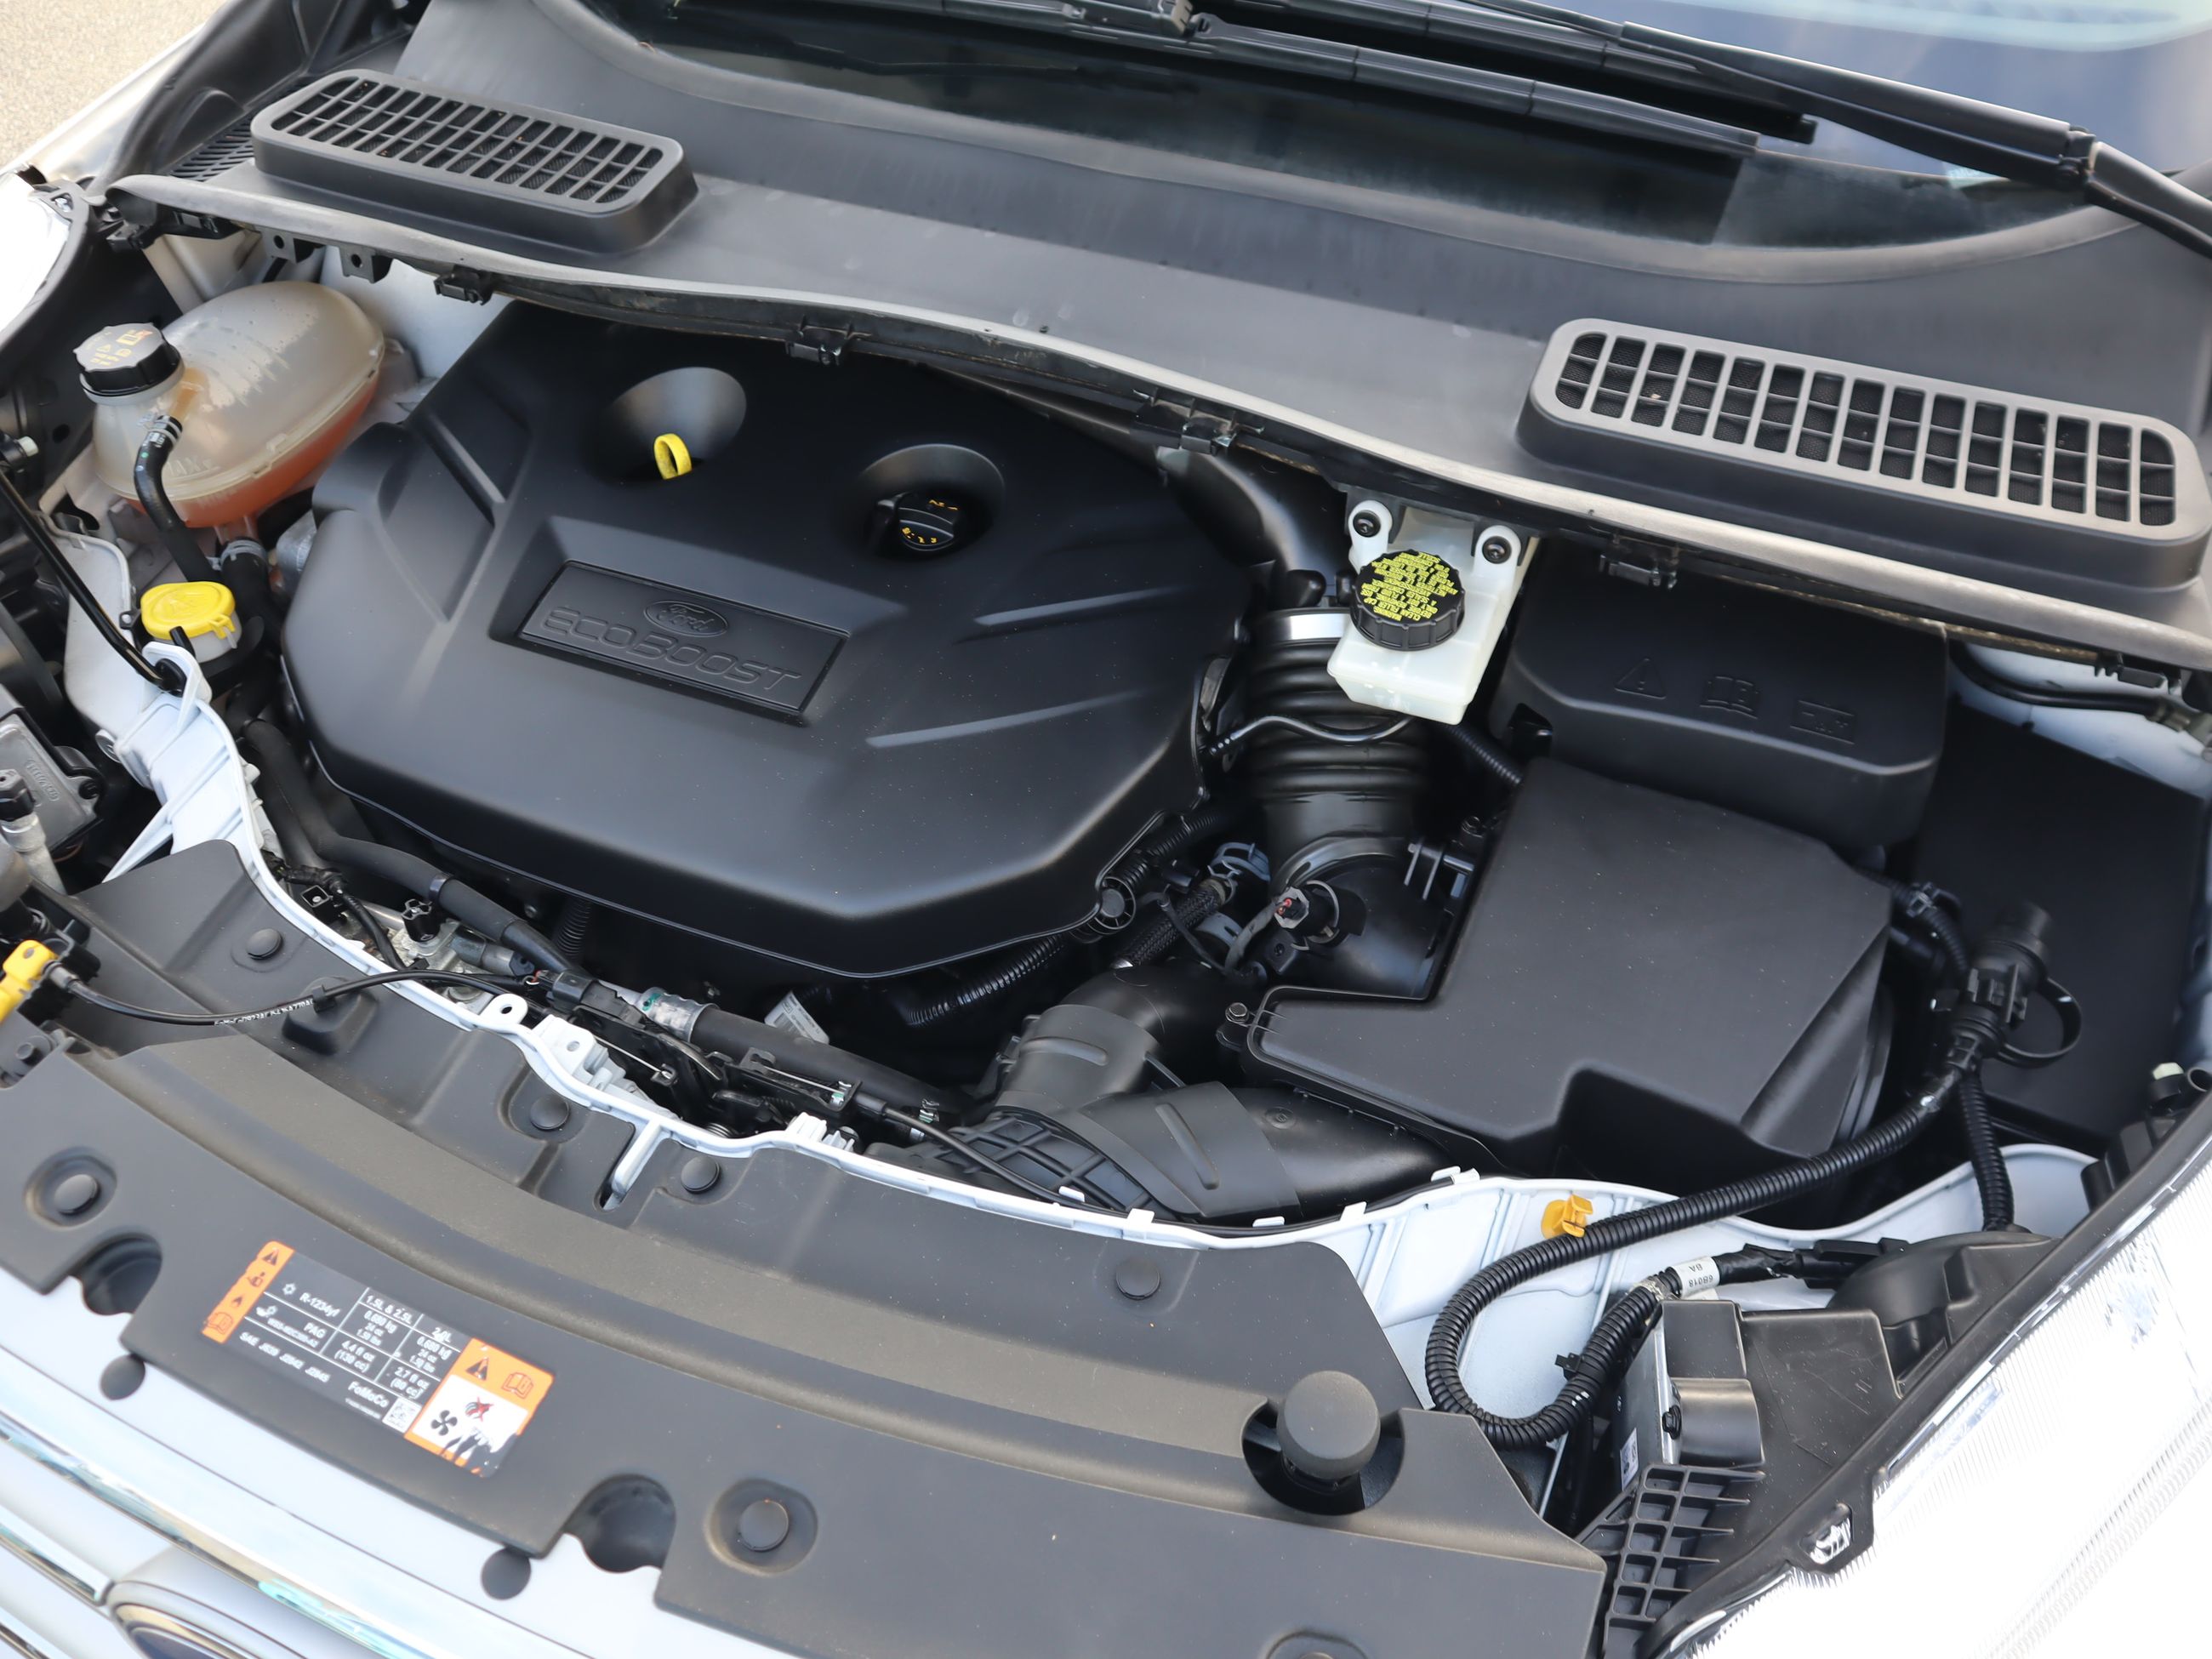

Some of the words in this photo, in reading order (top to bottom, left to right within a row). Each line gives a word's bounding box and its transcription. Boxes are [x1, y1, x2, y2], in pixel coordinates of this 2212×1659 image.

[1360, 588, 1374, 597] USE
[1361, 584, 1380, 592] FROM
[1381, 589, 1400, 598] FLUID
[1364, 596, 1377, 605] CAP
[1406, 591, 1430, 603] SEALED
[1378, 601, 1400, 613] FILLER
[658, 603, 712, 632] Ford
[1400, 609, 1421, 620] CLEAN
[299, 1293, 340, 1317] R-1234yf
[367, 1296, 385, 1310] 1.5L
[393, 1308, 413, 1324] 2.5L
[304, 1323, 326, 1339] PAG
[385, 1320, 397, 1334] kg
[240, 1332, 259, 1347] SAE
[342, 1341, 357, 1353] 4.4
[362, 1353, 375, 1362] oz
[438, 1347, 453, 1360] kg
[334, 1349, 356, 1365] (130
[354, 1360, 370, 1373] cc)
[395, 1367, 412, 1379] 2.7
[417, 1380, 430, 1390] oz
[349, 1382, 389, 1408] FoMoCo
